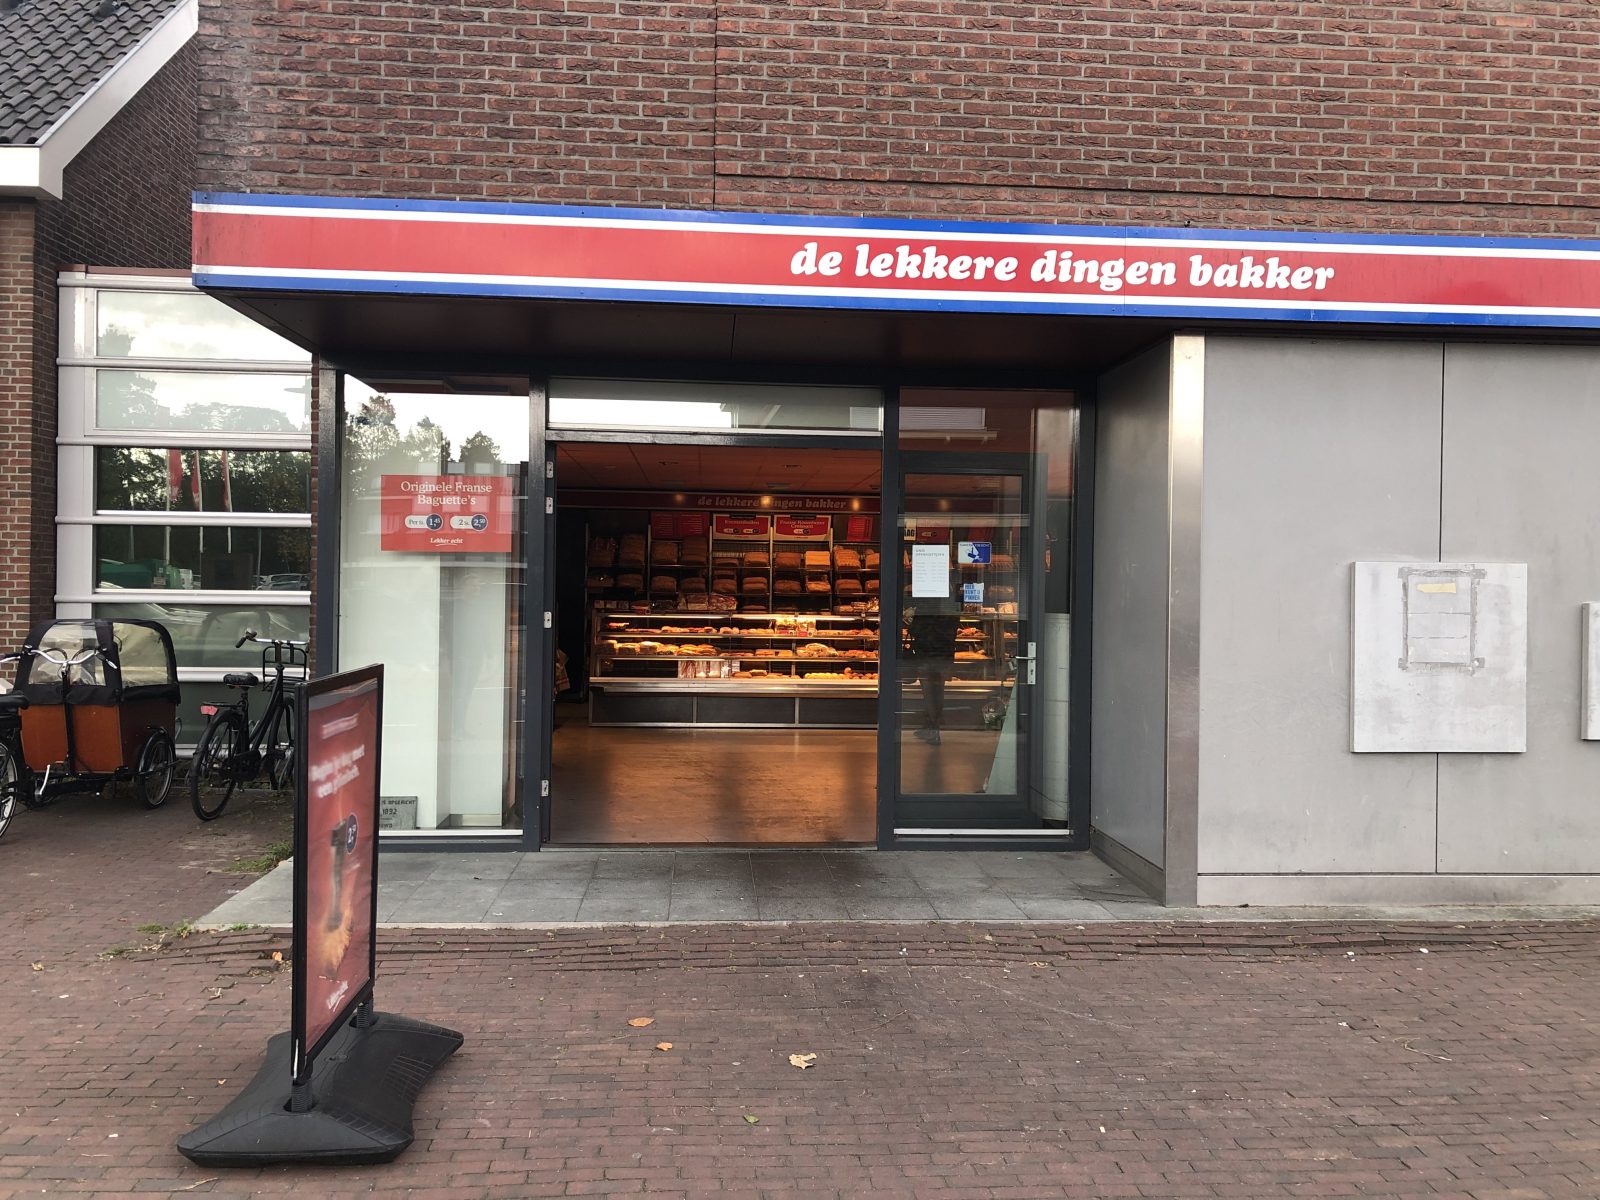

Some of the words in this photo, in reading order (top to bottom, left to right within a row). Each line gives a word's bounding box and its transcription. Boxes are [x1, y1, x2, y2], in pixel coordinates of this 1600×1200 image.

[790, 241, 843, 277] de
[854, 243, 1019, 282] lekkere
[1030, 249, 1177, 292] dingen
[1188, 254, 1335, 291] bakker
[400, 480, 453, 494] Originele
[454, 481, 493, 493] Franse
[417, 494, 477, 507] Baguette's
[715, 496, 760, 507] lekkere
[805, 498, 847, 509] bakker
